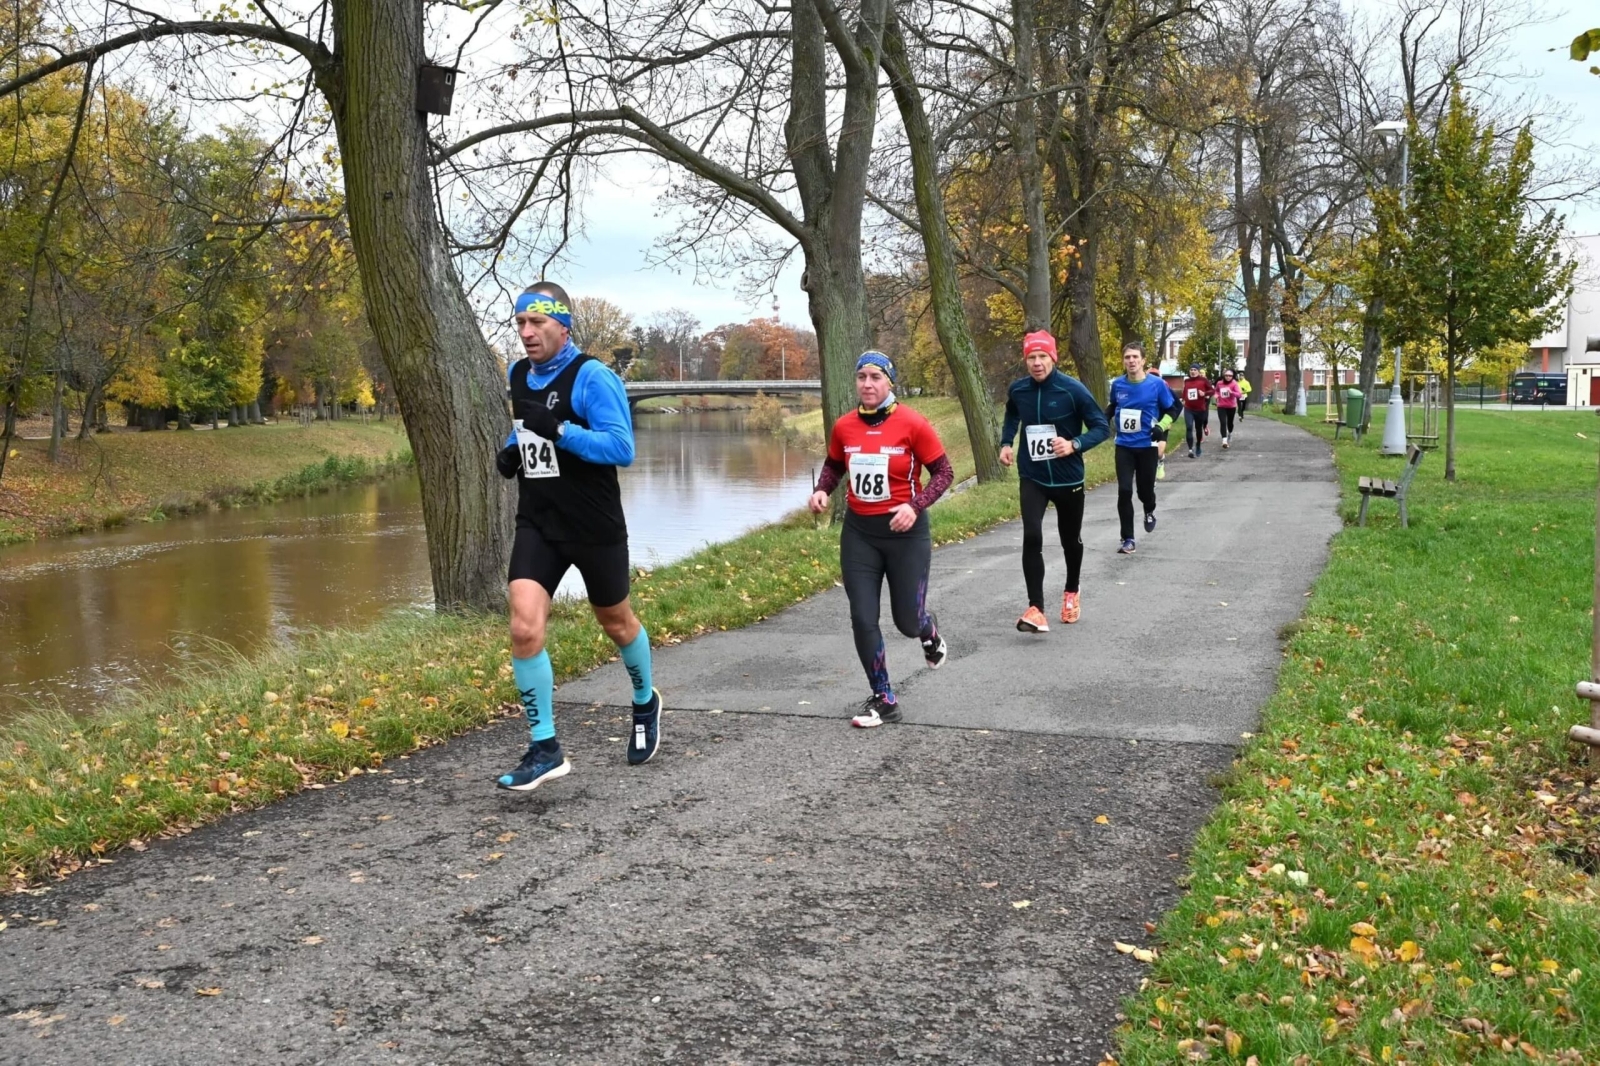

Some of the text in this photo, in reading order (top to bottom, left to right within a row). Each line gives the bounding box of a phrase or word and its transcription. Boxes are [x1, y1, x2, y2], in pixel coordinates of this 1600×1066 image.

[526, 299, 570, 315] eleve
[1123, 418, 1137, 430] 68
[521, 441, 552, 470] 134
[1031, 437, 1055, 456] 165
[855, 472, 885, 496] 168
